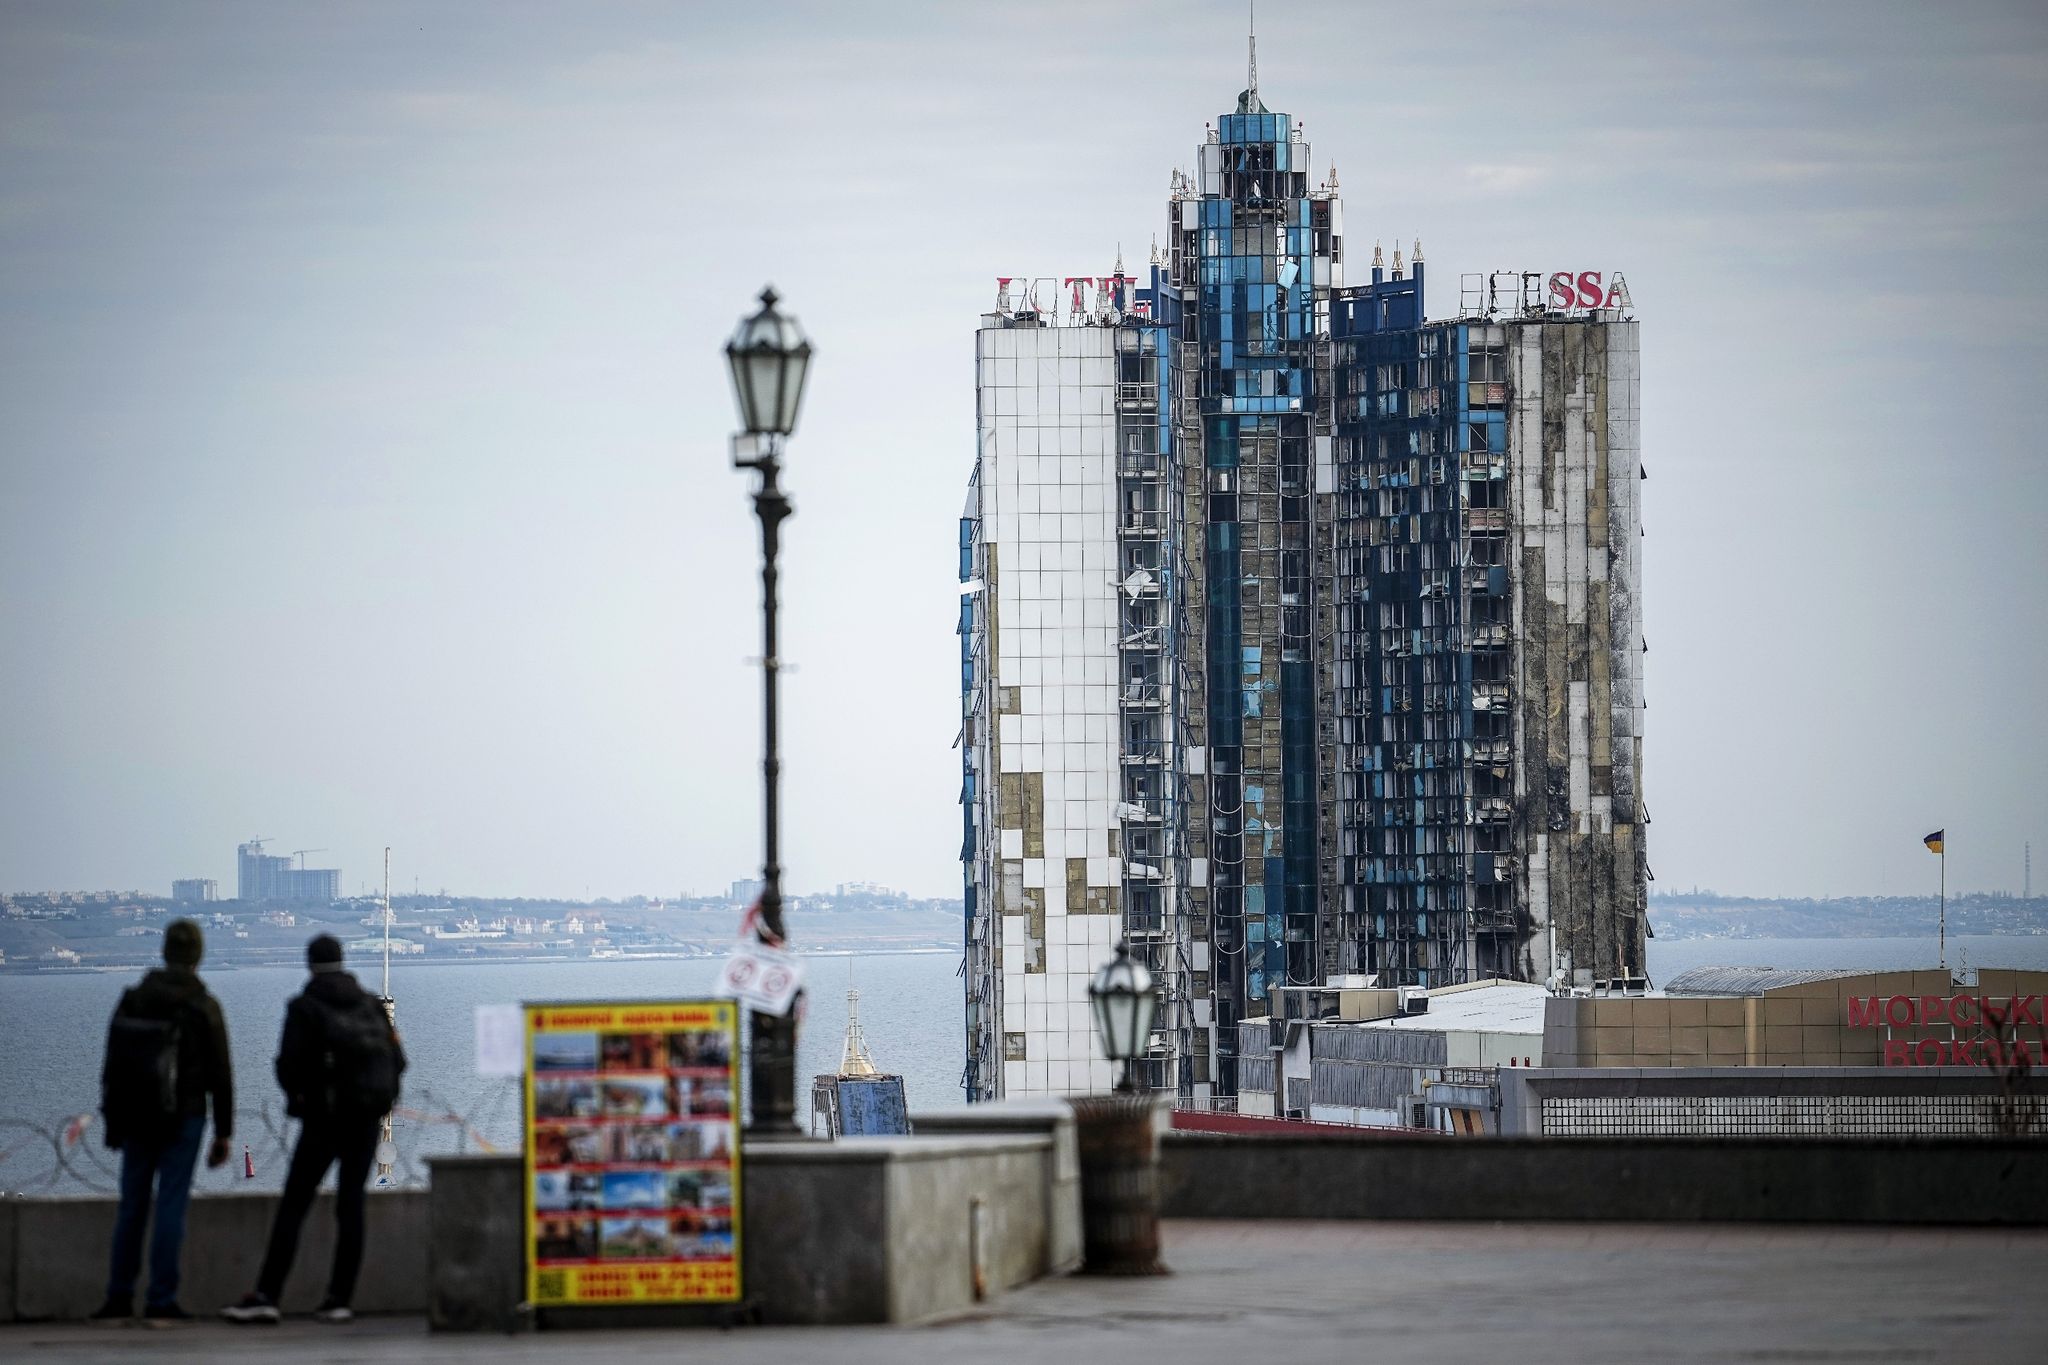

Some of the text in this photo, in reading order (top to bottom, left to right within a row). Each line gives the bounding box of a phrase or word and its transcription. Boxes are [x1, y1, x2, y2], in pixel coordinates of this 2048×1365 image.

[1461, 271, 1634, 310] SSA
[1847, 993, 2048, 1029] МОРСЬК
[1883, 1037, 2048, 1067] ВОКЗА
